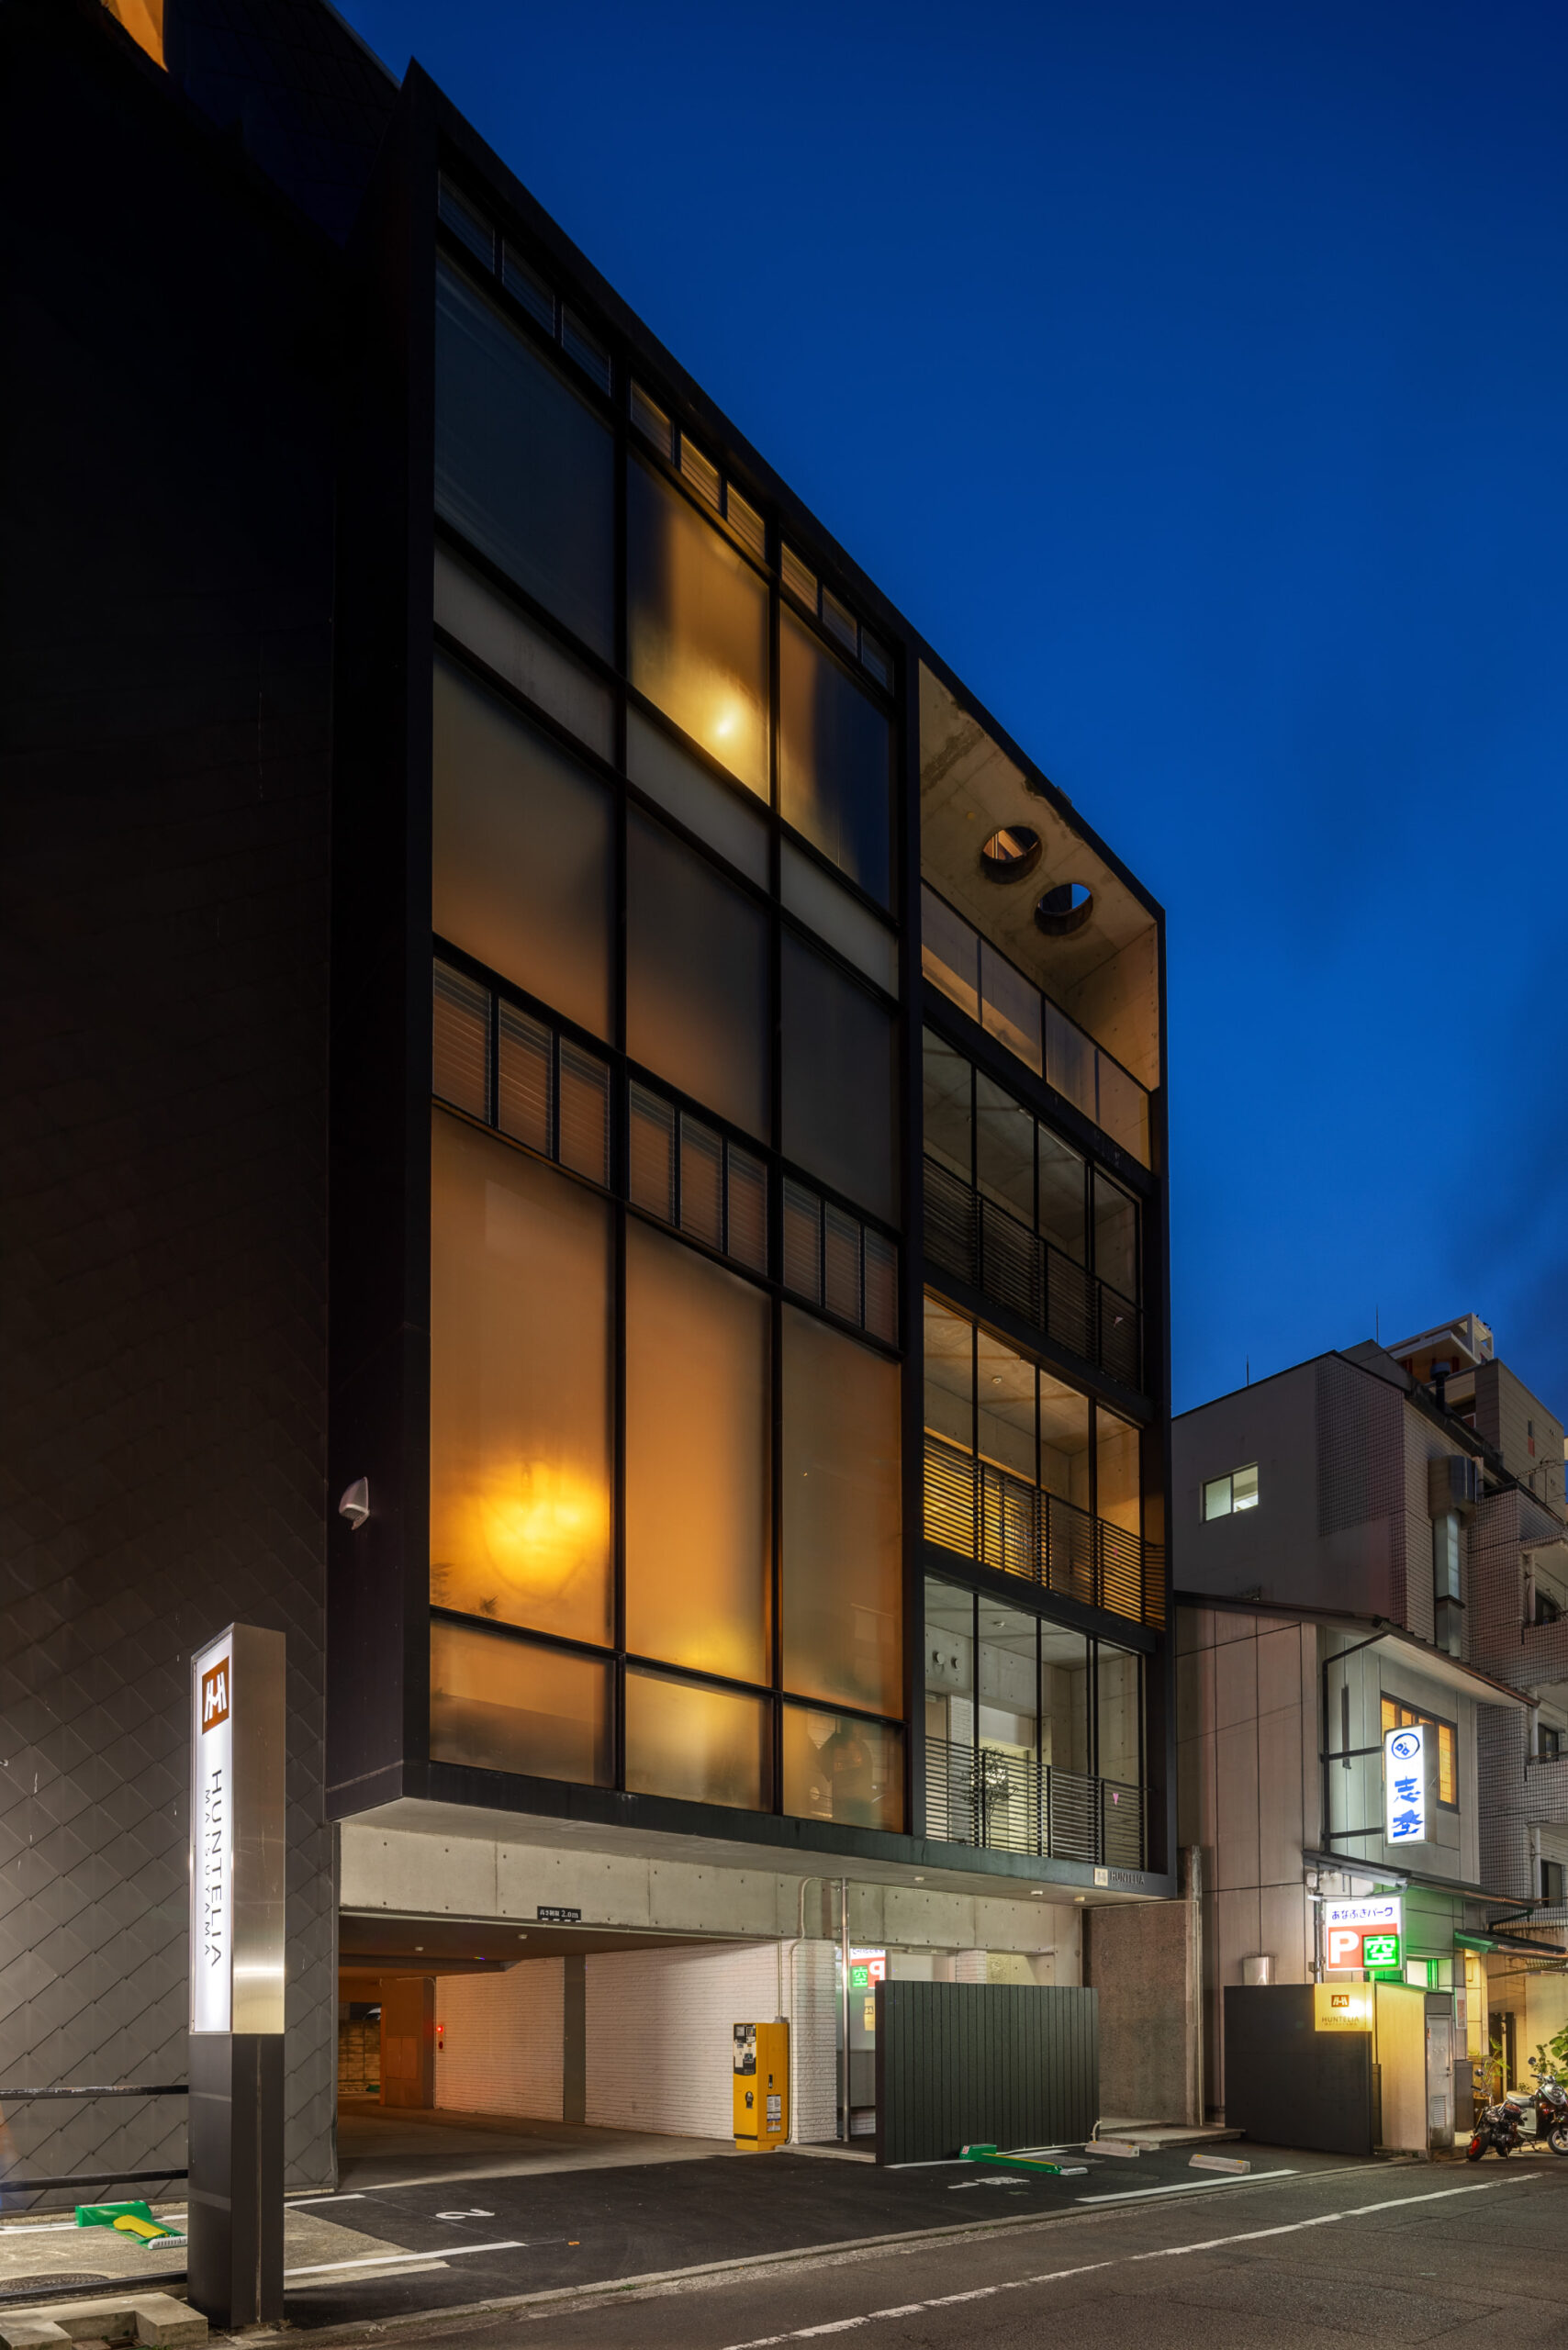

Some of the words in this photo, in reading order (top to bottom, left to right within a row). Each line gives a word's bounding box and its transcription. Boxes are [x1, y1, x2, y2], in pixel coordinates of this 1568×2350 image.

[211, 1769, 222, 1967] HUNTELIA
[1330, 1930, 1359, 1964] P
[1366, 1935, 1396, 1965] 空
[435, 2209, 496, 2220] 2
